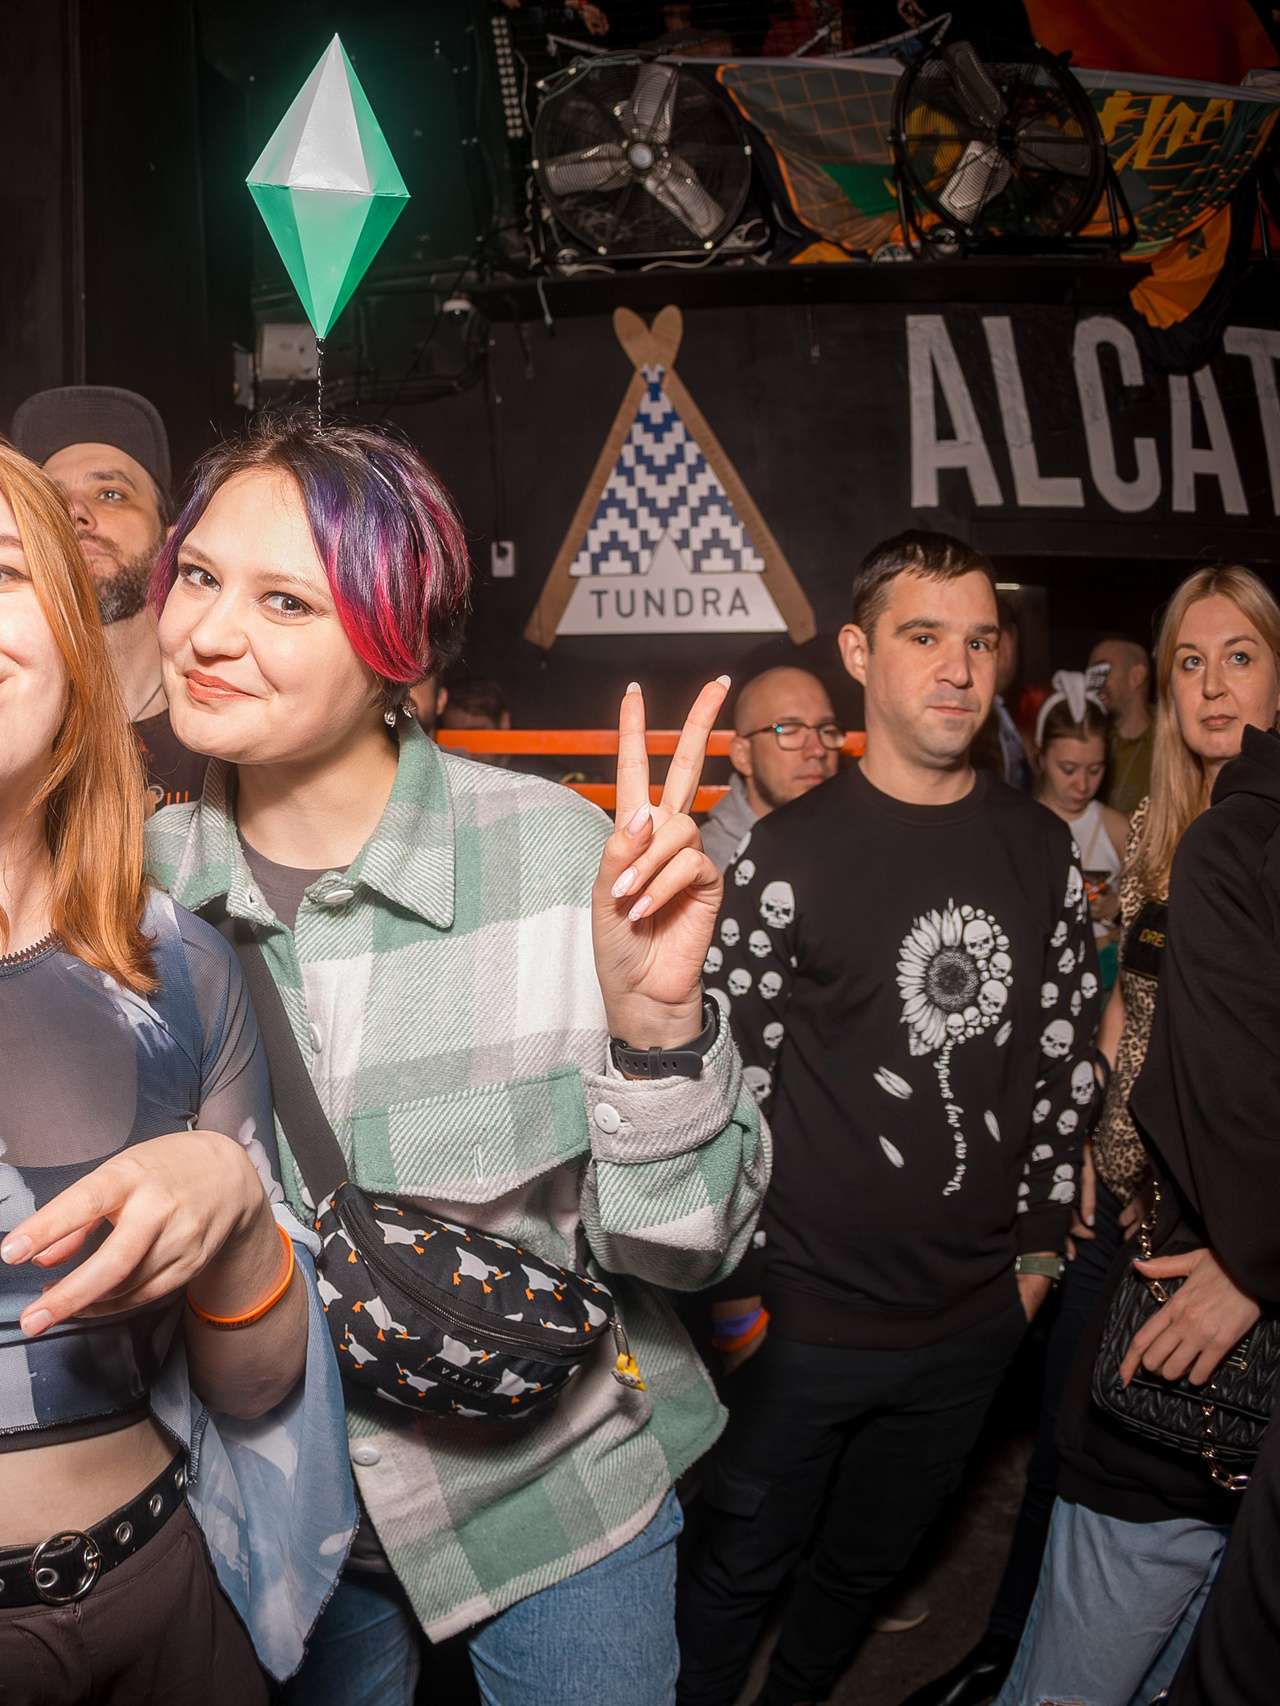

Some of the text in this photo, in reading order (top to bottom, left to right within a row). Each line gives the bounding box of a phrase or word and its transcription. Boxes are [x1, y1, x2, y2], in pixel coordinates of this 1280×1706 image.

[590, 587, 750, 619] TUNDRA
[944, 1102, 964, 1128] my
[953, 1130, 967, 1159] are
[942, 1162, 967, 1196] You
[441, 1367, 482, 1388] VAIN
